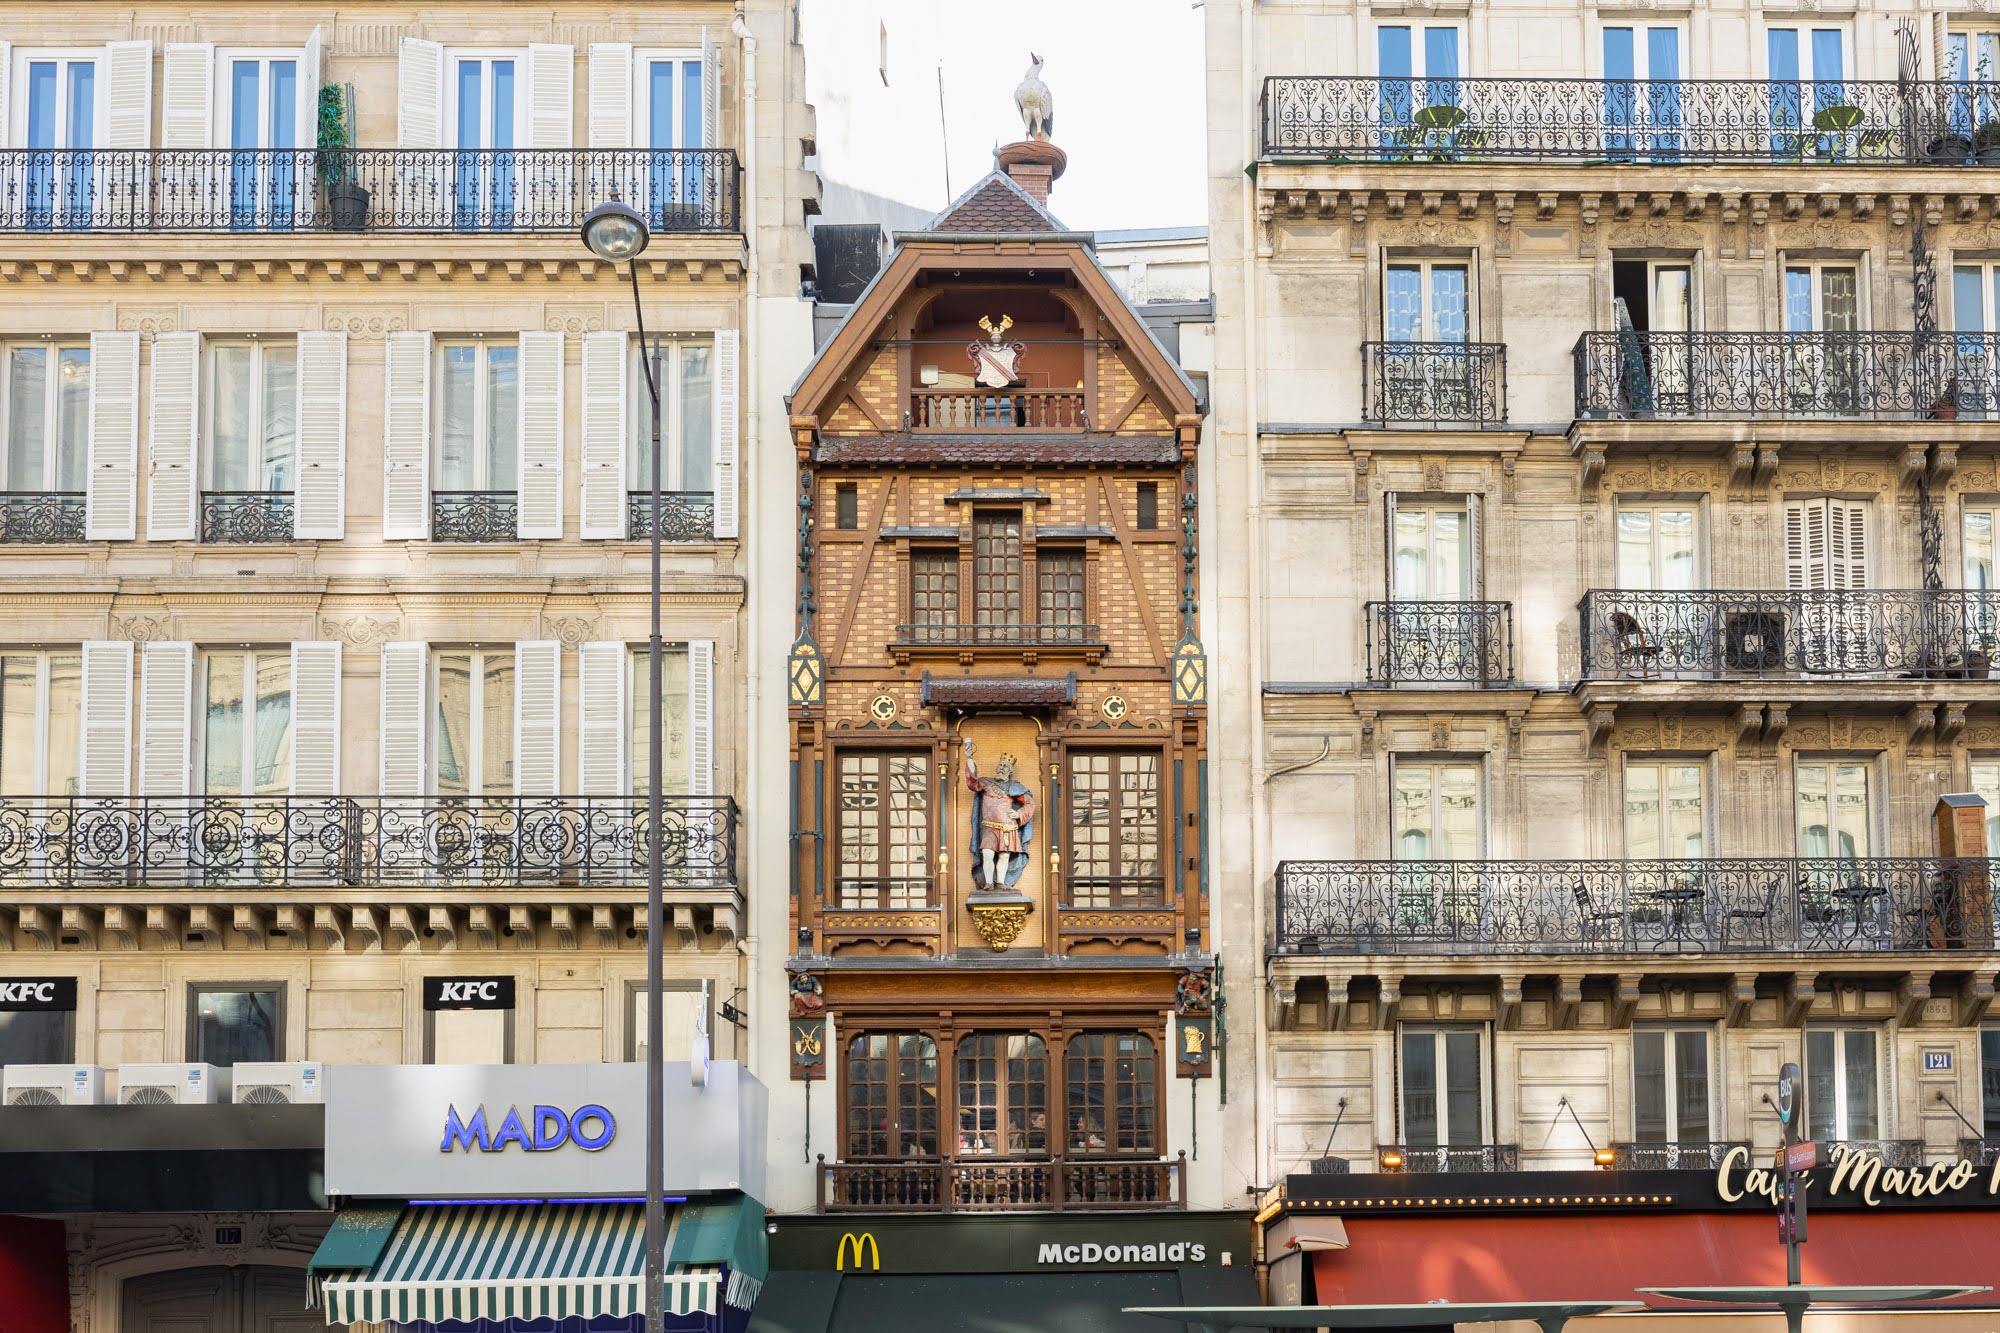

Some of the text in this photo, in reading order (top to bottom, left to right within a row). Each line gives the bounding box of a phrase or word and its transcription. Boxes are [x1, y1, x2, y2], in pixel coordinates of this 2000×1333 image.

[0, 983, 55, 1001] KFC
[439, 981, 498, 1001] KFC
[1926, 1004, 1948, 1014] 1868
[1928, 1053, 1948, 1068] 121
[1780, 1078, 1792, 1098] BUS
[440, 1103, 617, 1153] MADO
[1718, 1146, 1814, 1206] Ca
[1830, 1144, 1978, 1206] Marco
[218, 1229, 239, 1243] 117
[1038, 1242, 1206, 1264] McDonald's
